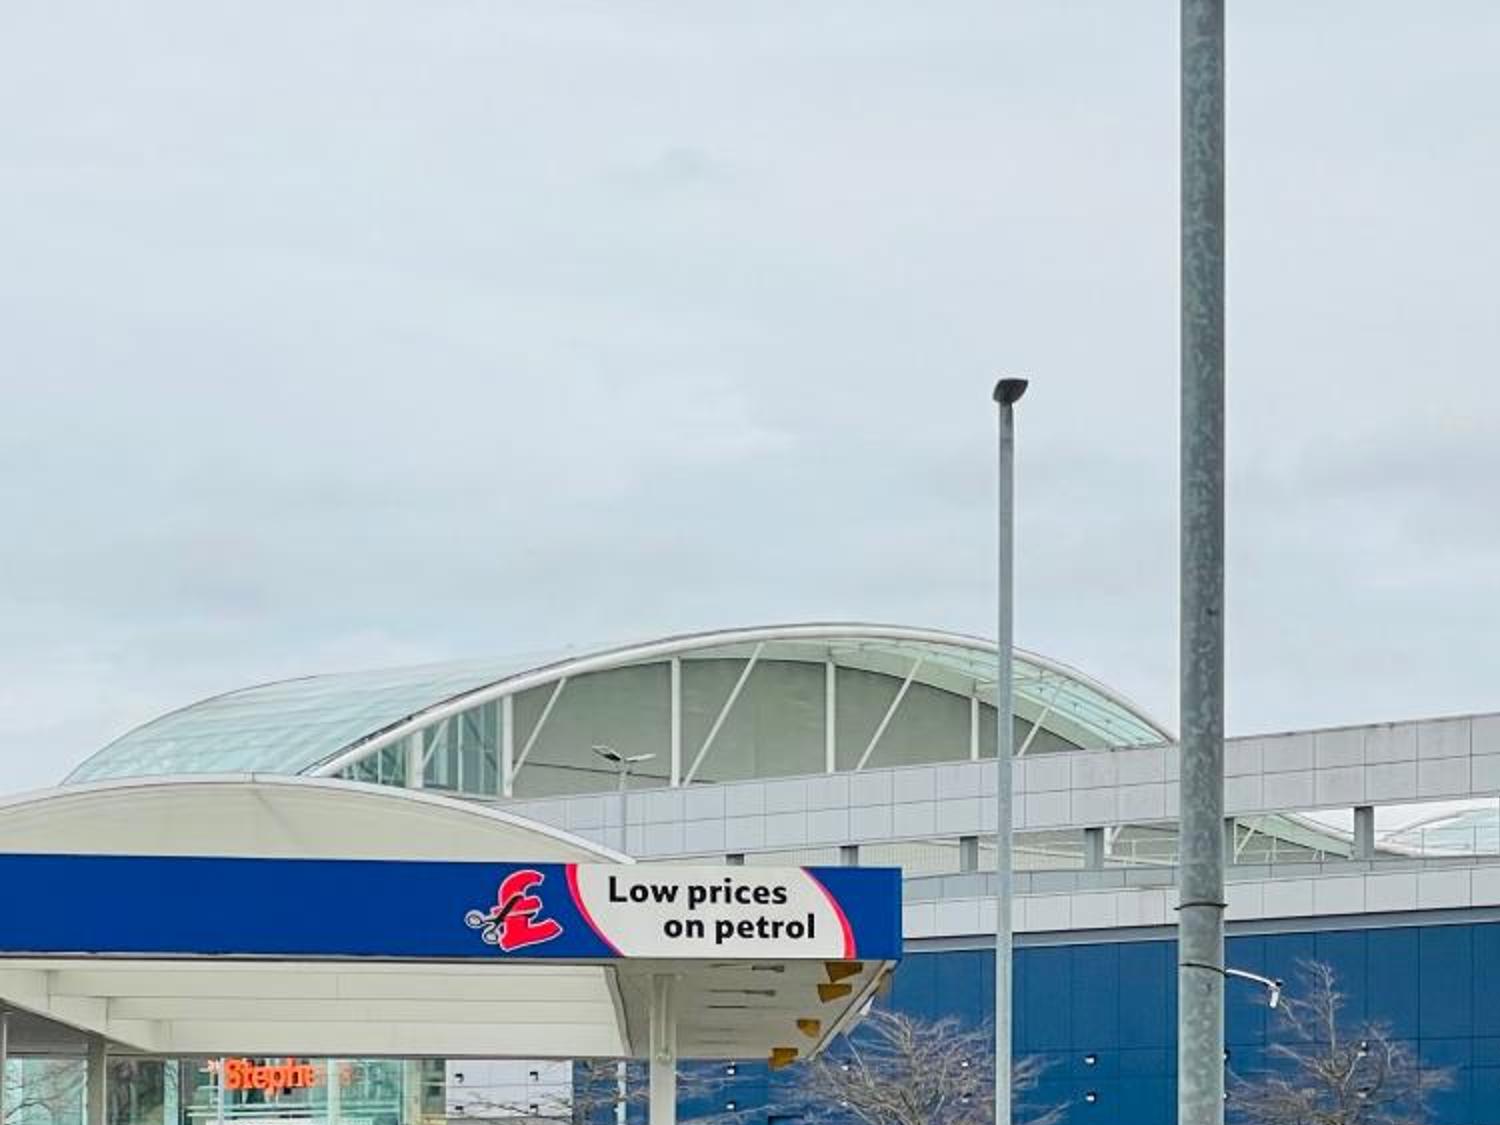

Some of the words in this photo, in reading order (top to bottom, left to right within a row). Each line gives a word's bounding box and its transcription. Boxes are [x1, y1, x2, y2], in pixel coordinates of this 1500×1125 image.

[608, 876, 679, 903] Low
[688, 878, 787, 910] prices
[664, 919, 705, 938] on
[715, 913, 815, 944] petrol
